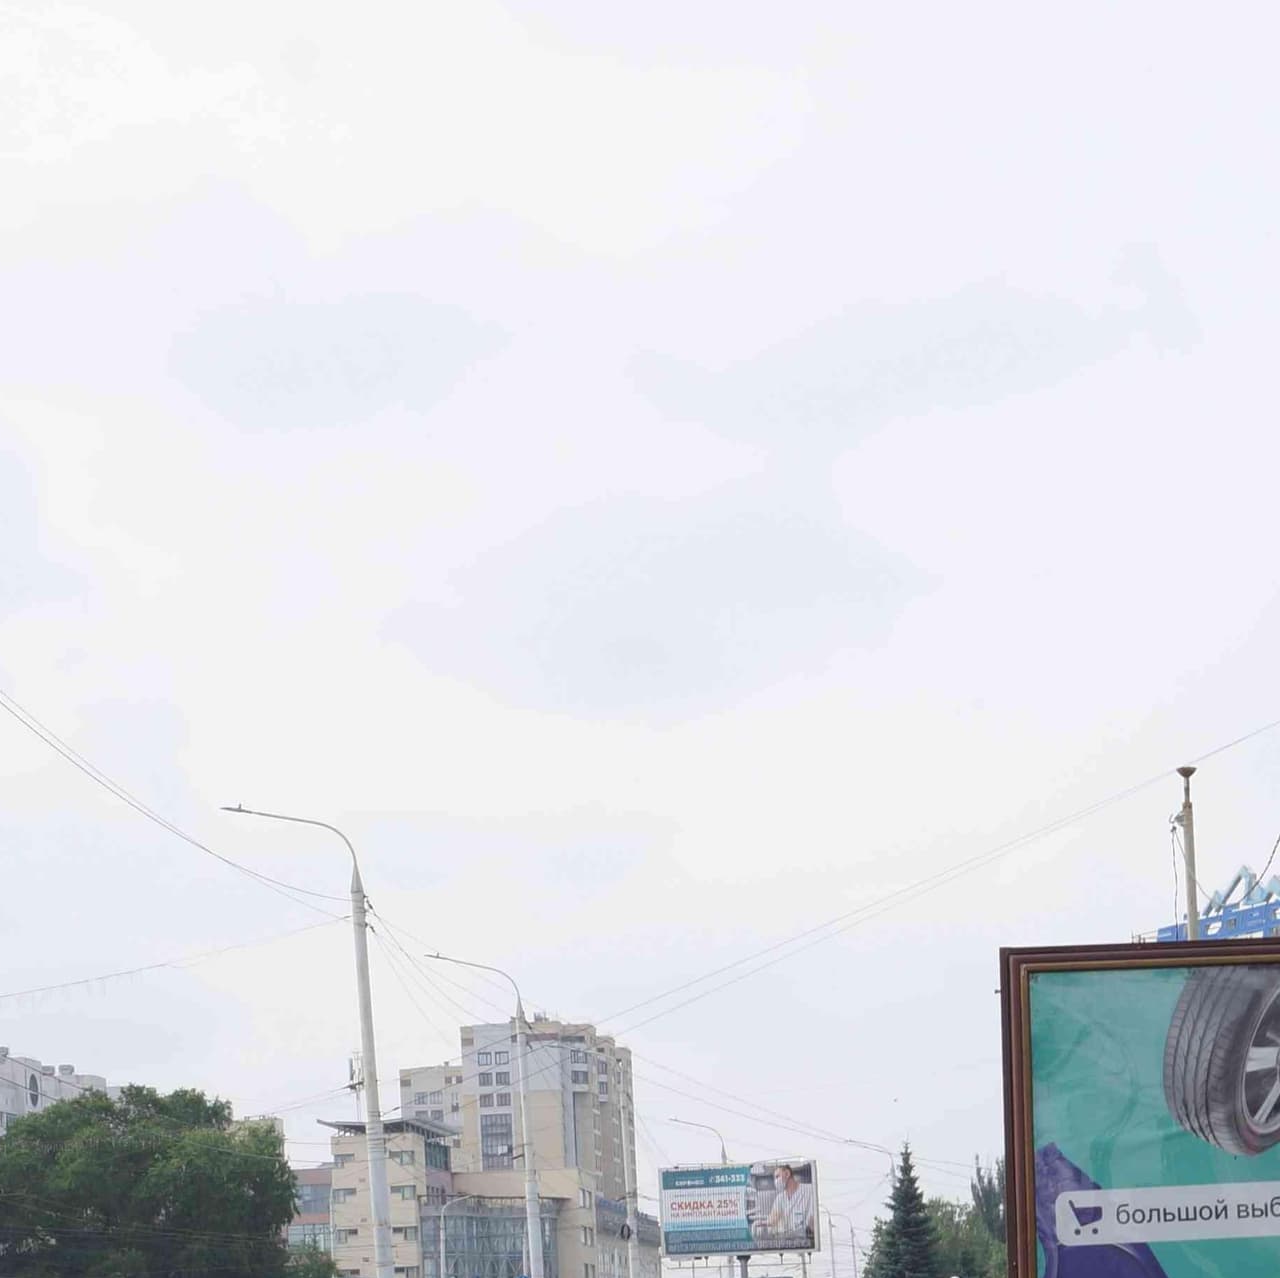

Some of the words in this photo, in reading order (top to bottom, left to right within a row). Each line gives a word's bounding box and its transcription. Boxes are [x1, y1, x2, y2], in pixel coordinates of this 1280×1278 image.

[671, 1200, 714, 1211] СКИДКА
[717, 1199, 739, 1210] 25%
[1116, 1199, 1229, 1226] большой
